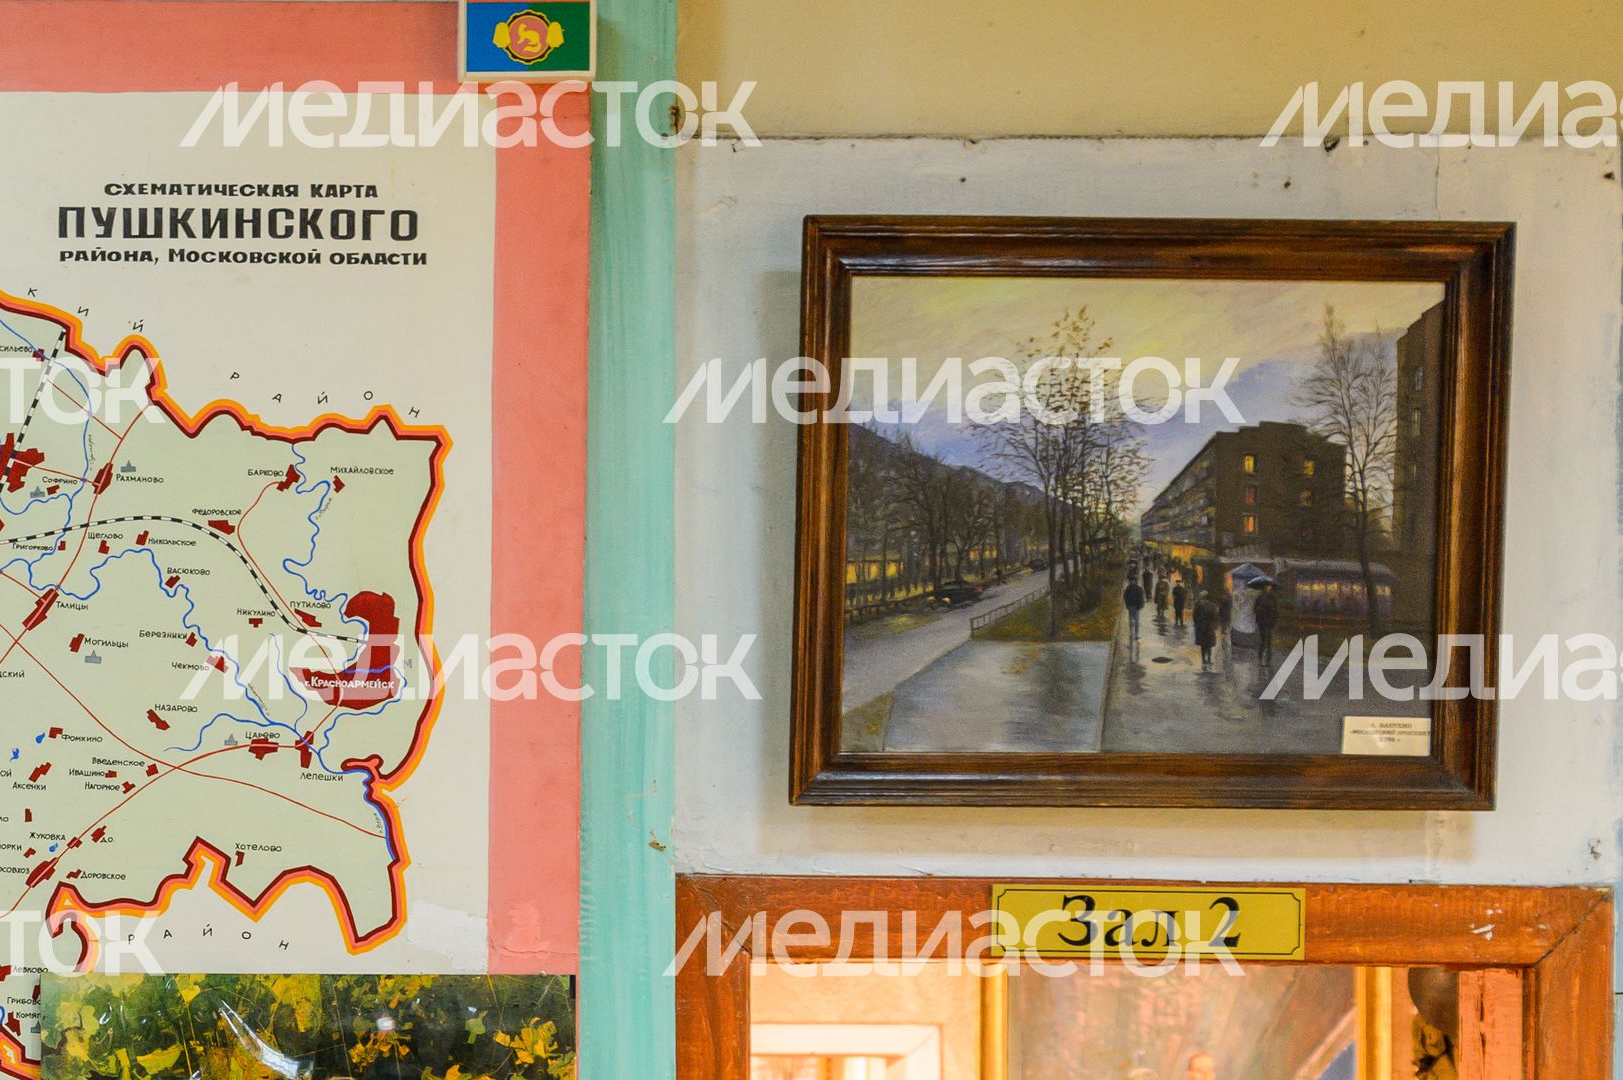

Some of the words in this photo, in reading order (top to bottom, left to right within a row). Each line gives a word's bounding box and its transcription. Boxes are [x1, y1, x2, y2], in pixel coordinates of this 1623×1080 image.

[104, 183, 299, 198] СХЕМАТИЧЕСКАЯ
[310, 184, 378, 199] КАРТА
[58, 206, 419, 242] ПУШКИНСКОГО
[59, 247, 159, 266] РАЙОНА,
[329, 252, 427, 266] ОБЛАСТИ
[1058, 894, 1180, 947] Зал
[1208, 896, 1242, 948] 2
